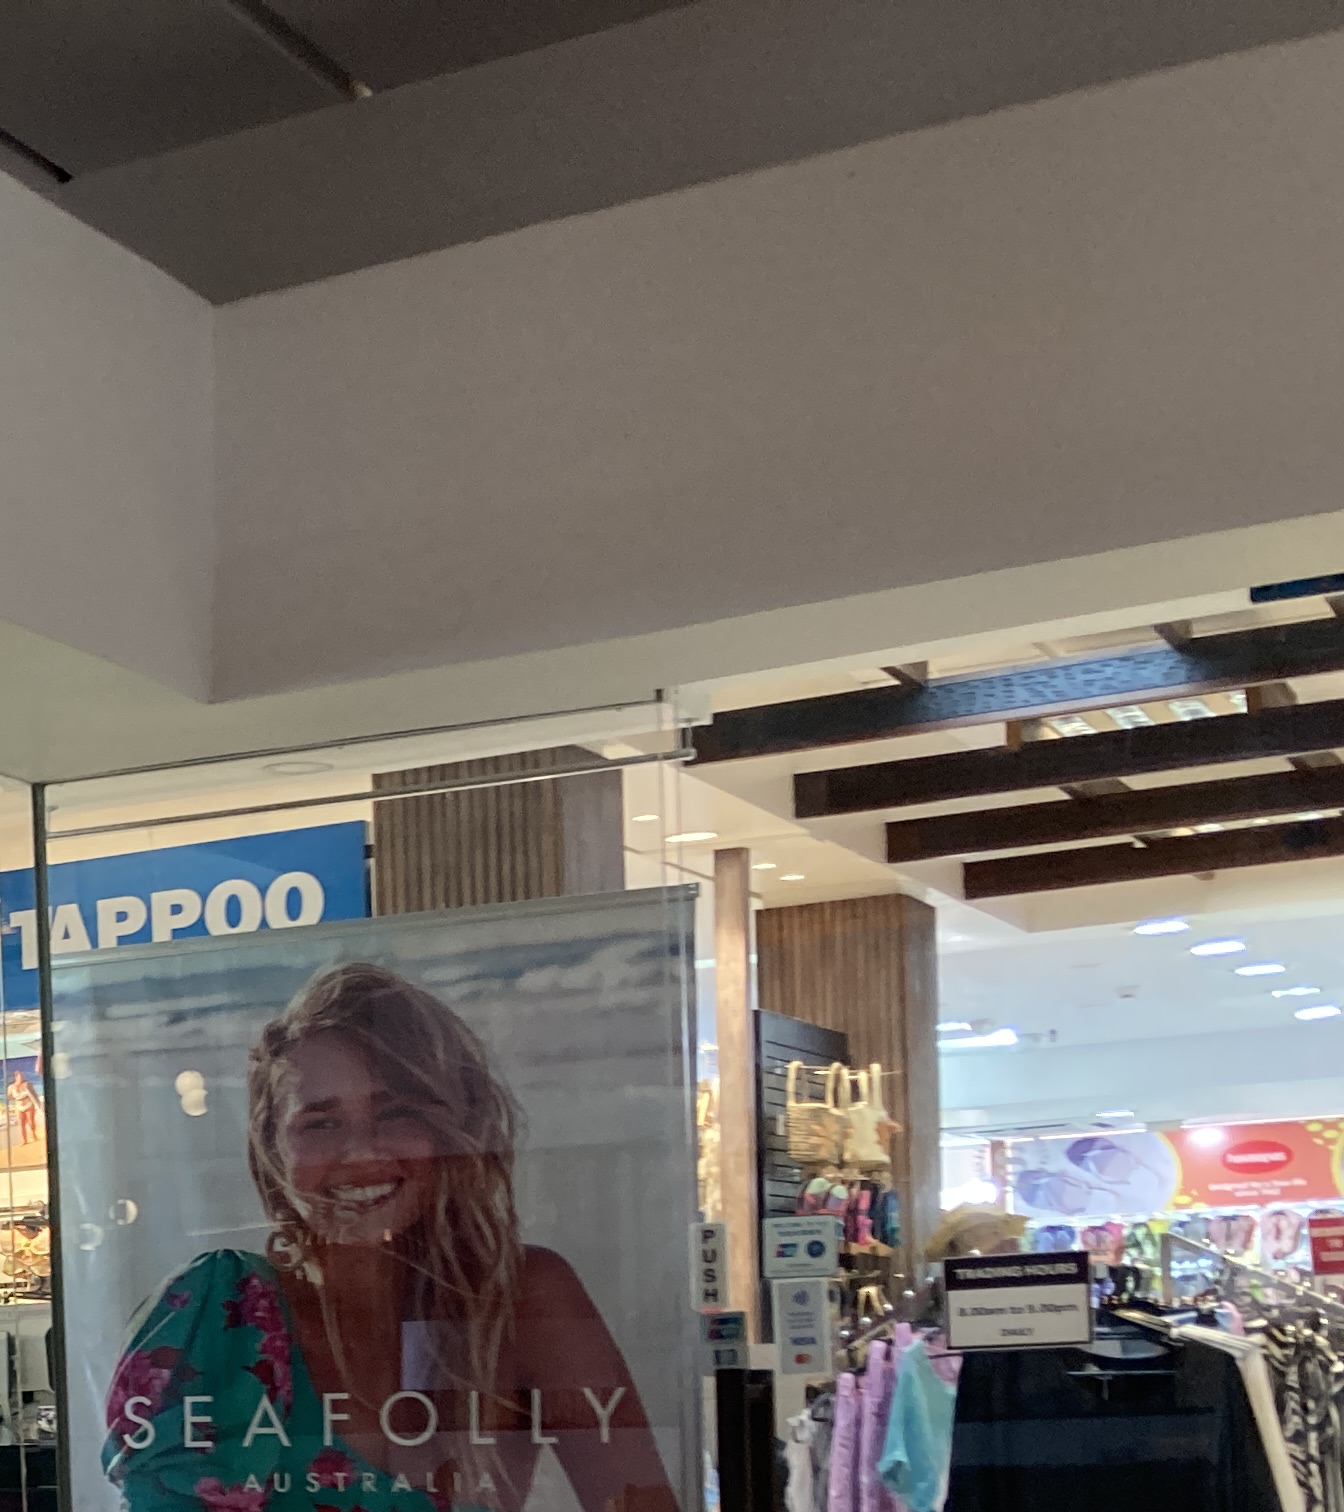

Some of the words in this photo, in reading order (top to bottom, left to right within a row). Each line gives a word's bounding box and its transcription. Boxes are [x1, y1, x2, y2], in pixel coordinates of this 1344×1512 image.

[9, 871, 325, 970] TAPPOO
[701, 1229, 719, 1302] PUSH
[123, 1386, 626, 1450] SEAFOLLY
[244, 1471, 498, 1494] AUSTRALIA
